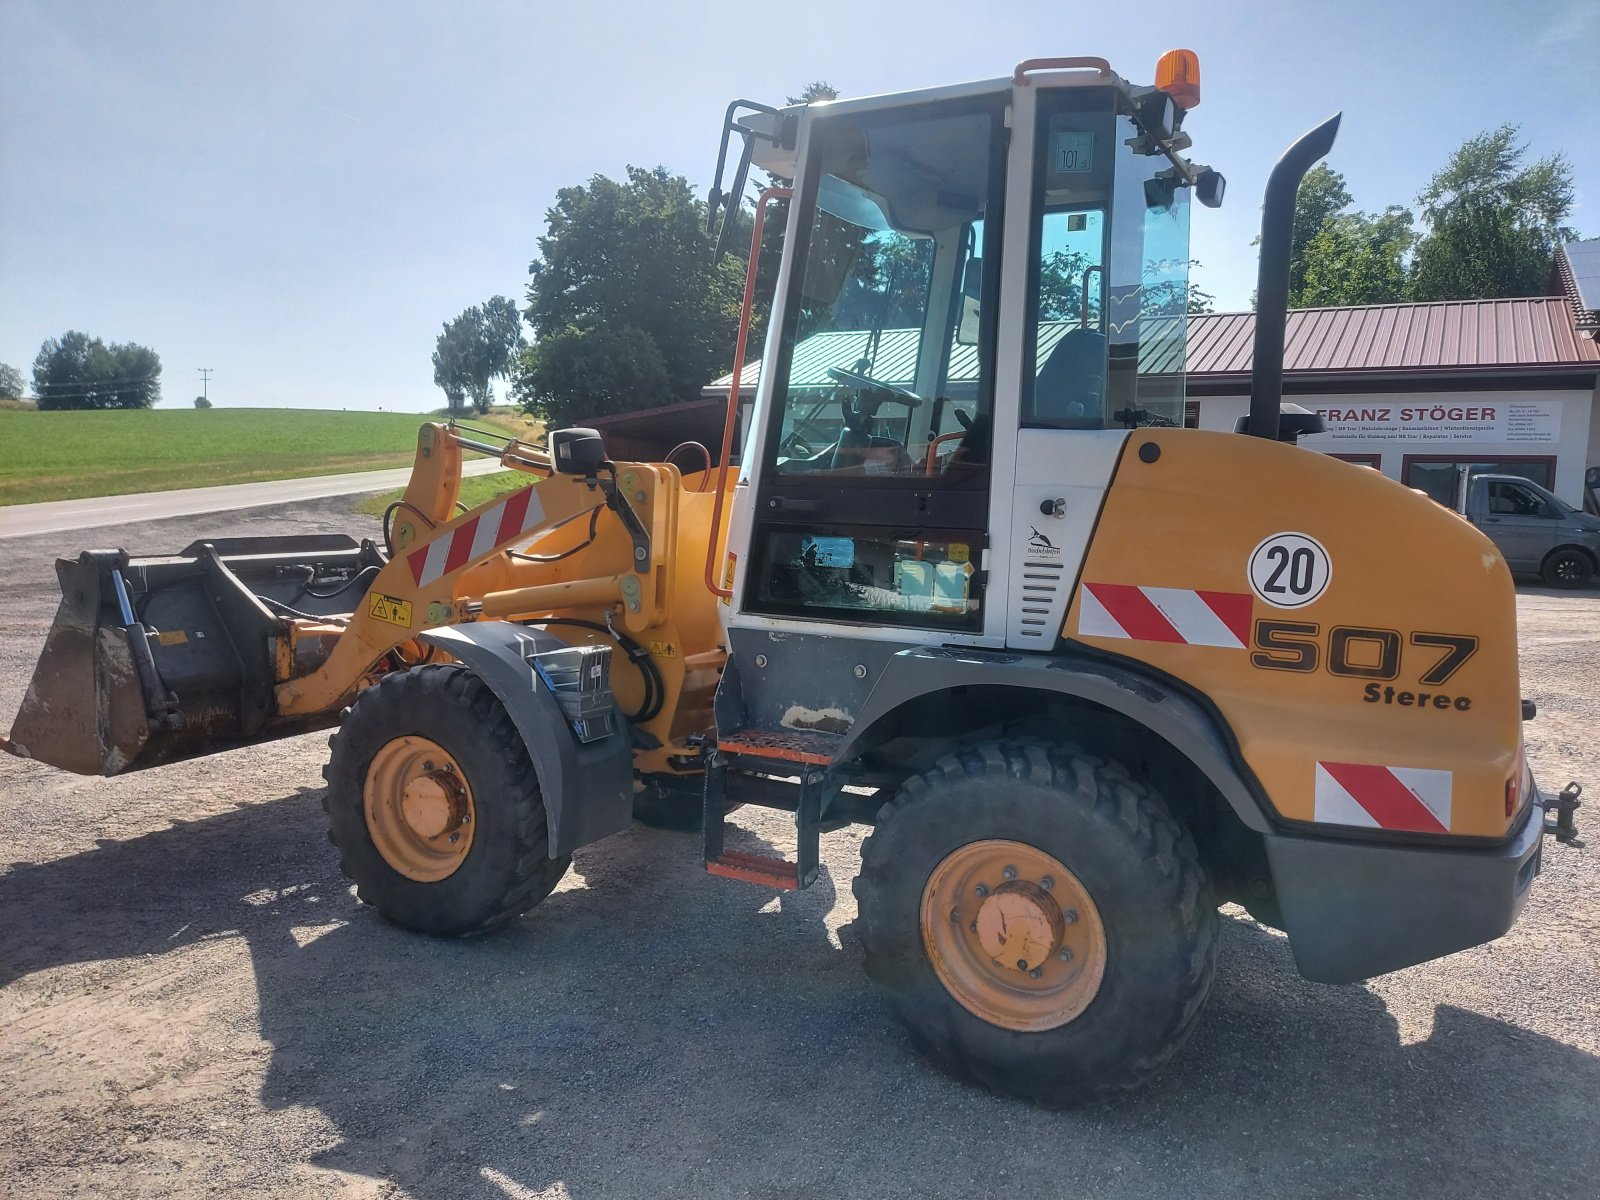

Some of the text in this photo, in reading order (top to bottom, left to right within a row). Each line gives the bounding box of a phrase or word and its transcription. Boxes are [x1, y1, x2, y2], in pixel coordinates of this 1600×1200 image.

[1062, 150, 1078, 169] 101
[1316, 405, 1496, 421] FRANZ STÖGER
[1263, 545, 1316, 596] 20
[1250, 618, 1480, 687] 507
